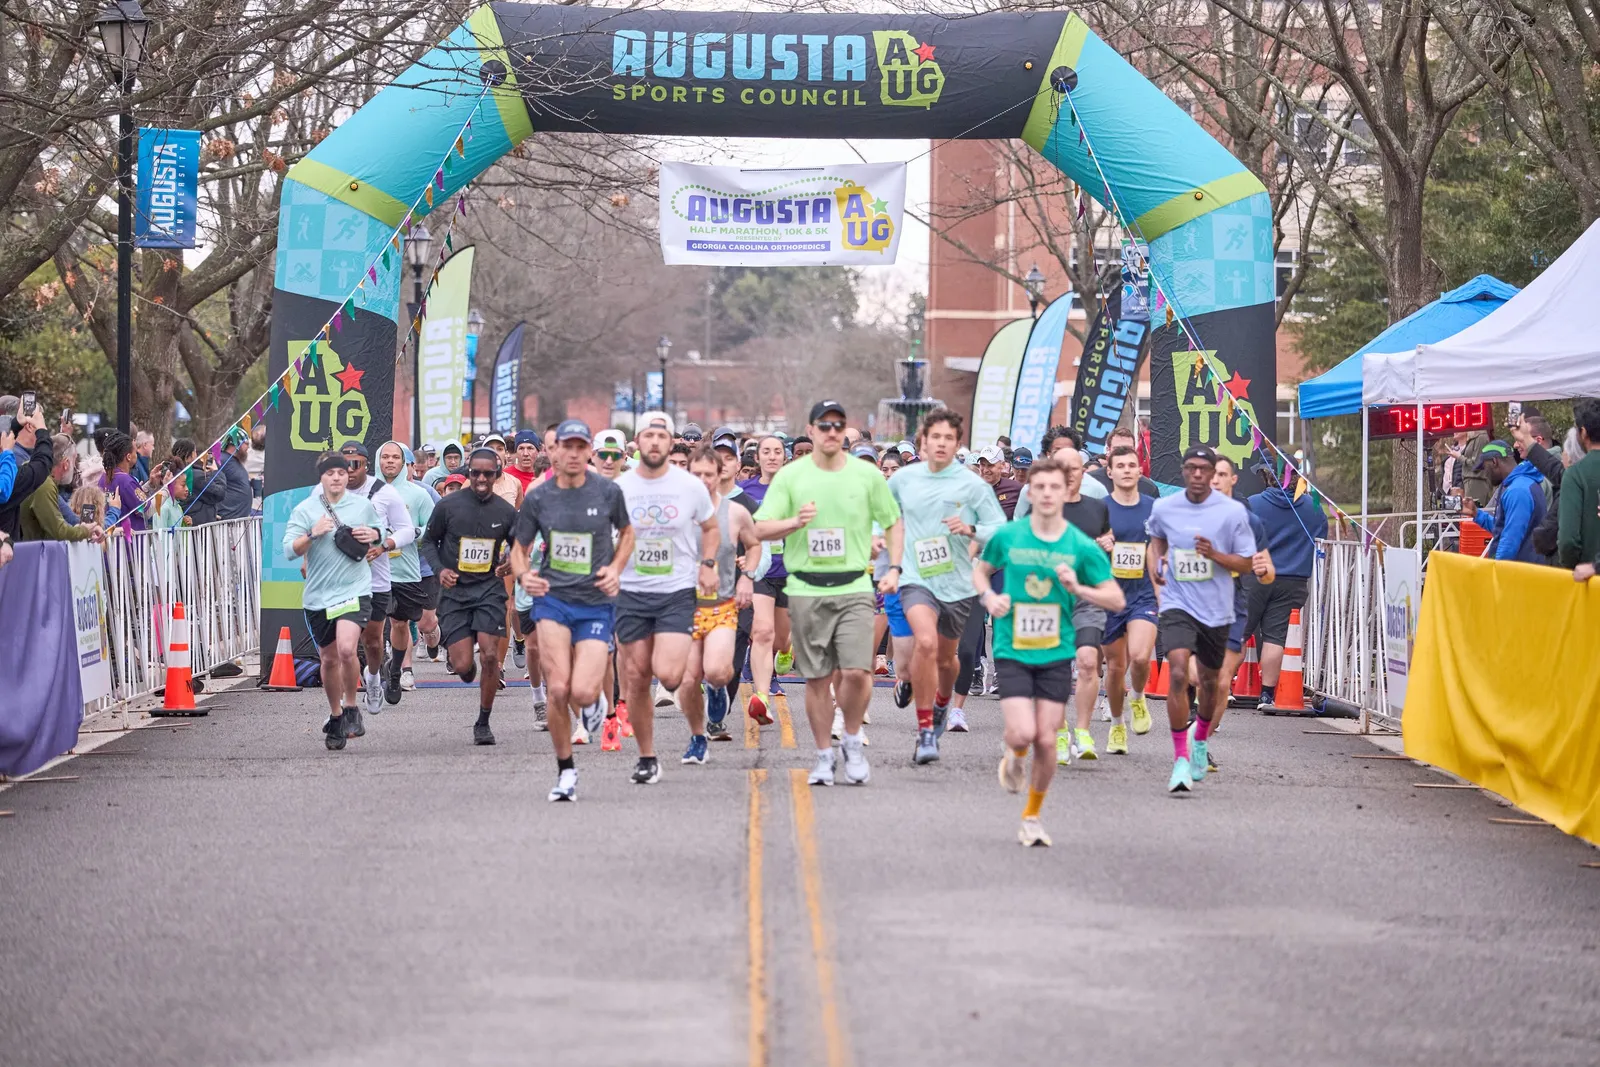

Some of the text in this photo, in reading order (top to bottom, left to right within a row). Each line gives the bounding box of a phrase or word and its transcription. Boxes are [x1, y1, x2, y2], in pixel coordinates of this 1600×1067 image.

[612, 30, 866, 81] AUGUSTA
[613, 84, 866, 106] SPORTS COUNCIL
[150, 143, 178, 236] AUGUSTA
[176, 146, 187, 234] UNIVERSITY
[688, 195, 831, 225] AUGUSTA
[690, 226, 717, 234] HALF
[785, 227, 803, 235] 10K
[805, 227, 813, 235] &
[814, 227, 829, 235] 5K
[771, 243, 826, 251] ORTHOPEDICS
[1084, 315, 1109, 388] SPORTS
[556, 544, 586, 559] 2354
[812, 539, 841, 552] 2168
[464, 548, 490, 560] 1075
[639, 550, 668, 562] 2298
[919, 546, 947, 563] 2333
[1116, 554, 1142, 566] 1263
[1179, 562, 1207, 574] 2143
[1022, 618, 1054, 632] 1172
